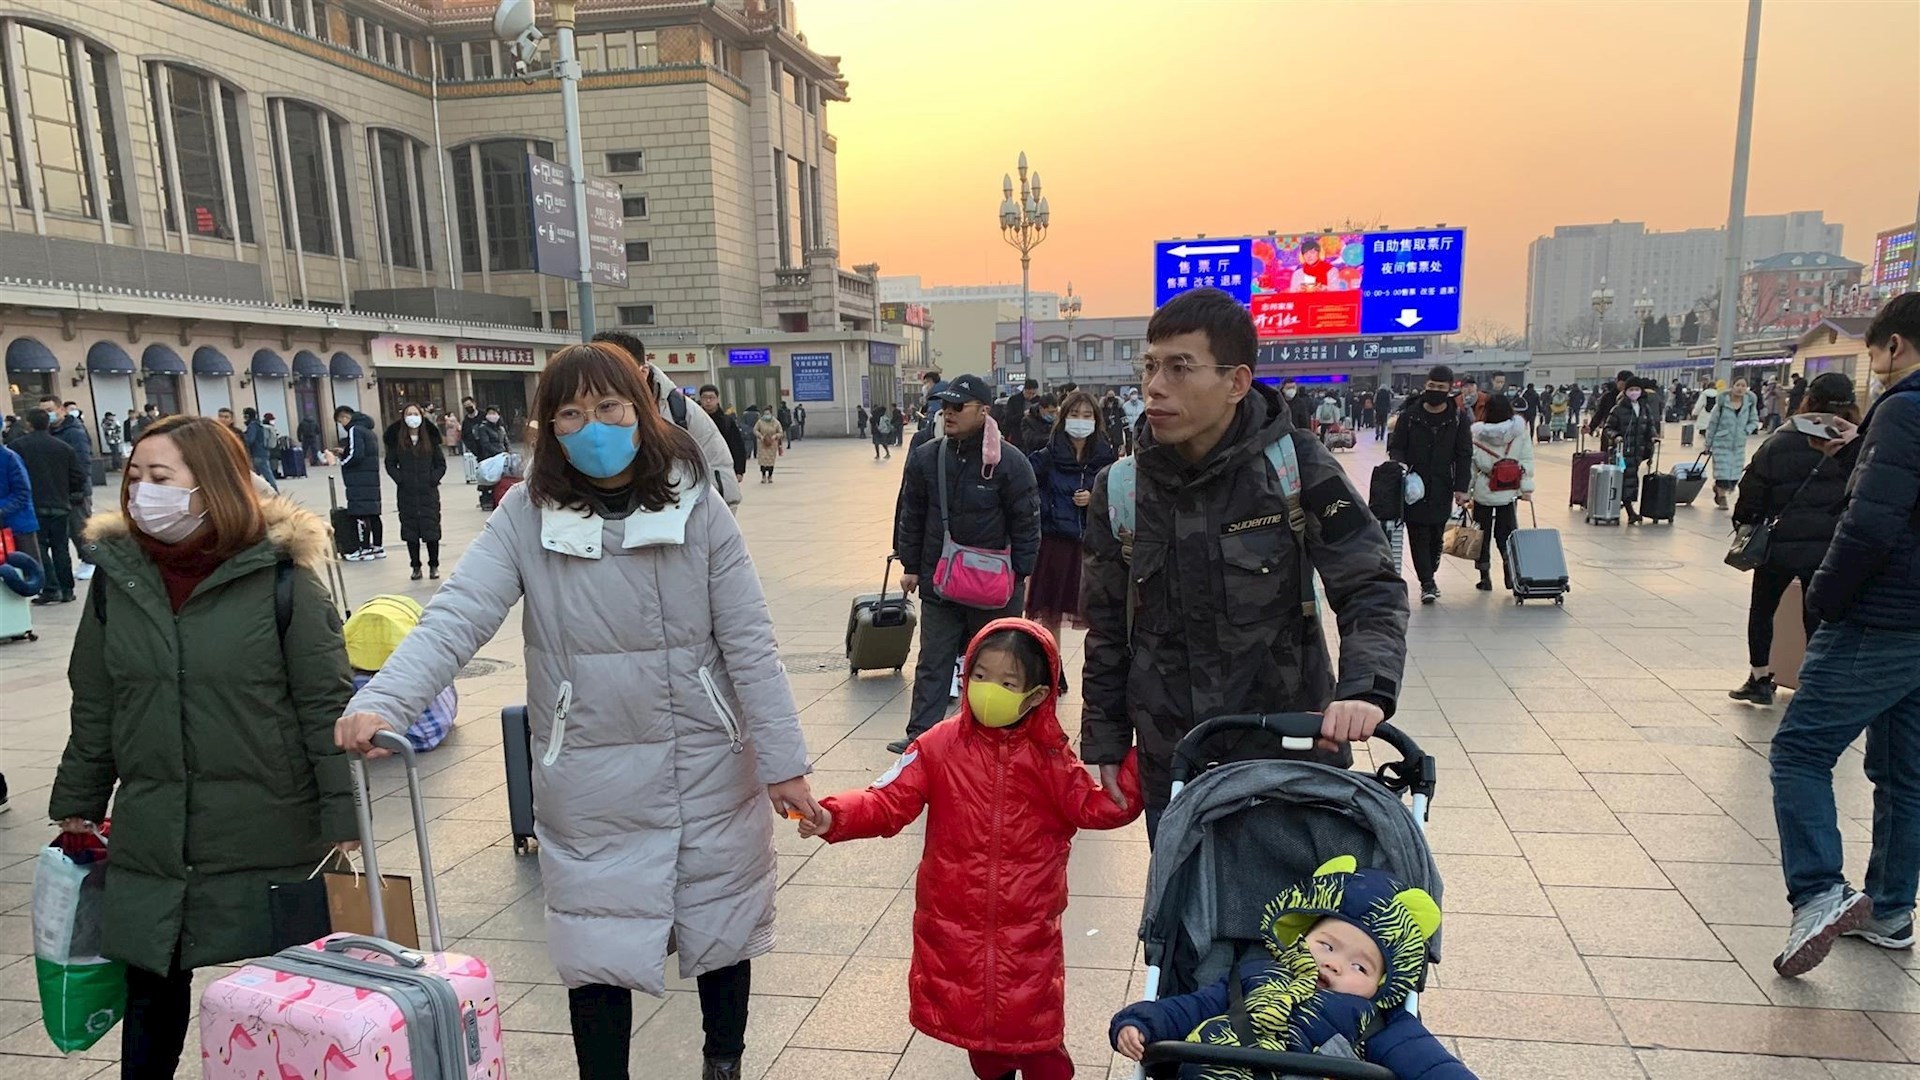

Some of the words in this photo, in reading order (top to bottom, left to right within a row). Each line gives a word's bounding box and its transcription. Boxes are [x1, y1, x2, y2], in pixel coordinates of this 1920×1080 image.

[1373, 236, 1454, 253] 自助售取票厅
[1178, 258, 1231, 274] 售票厅
[1381, 260, 1442, 275] 夜间售票处
[1166, 276, 1188, 289] 售票
[1193, 275, 1215, 288] 改签
[1220, 274, 1242, 287] 退票
[394, 342, 439, 360] 行李寄存
